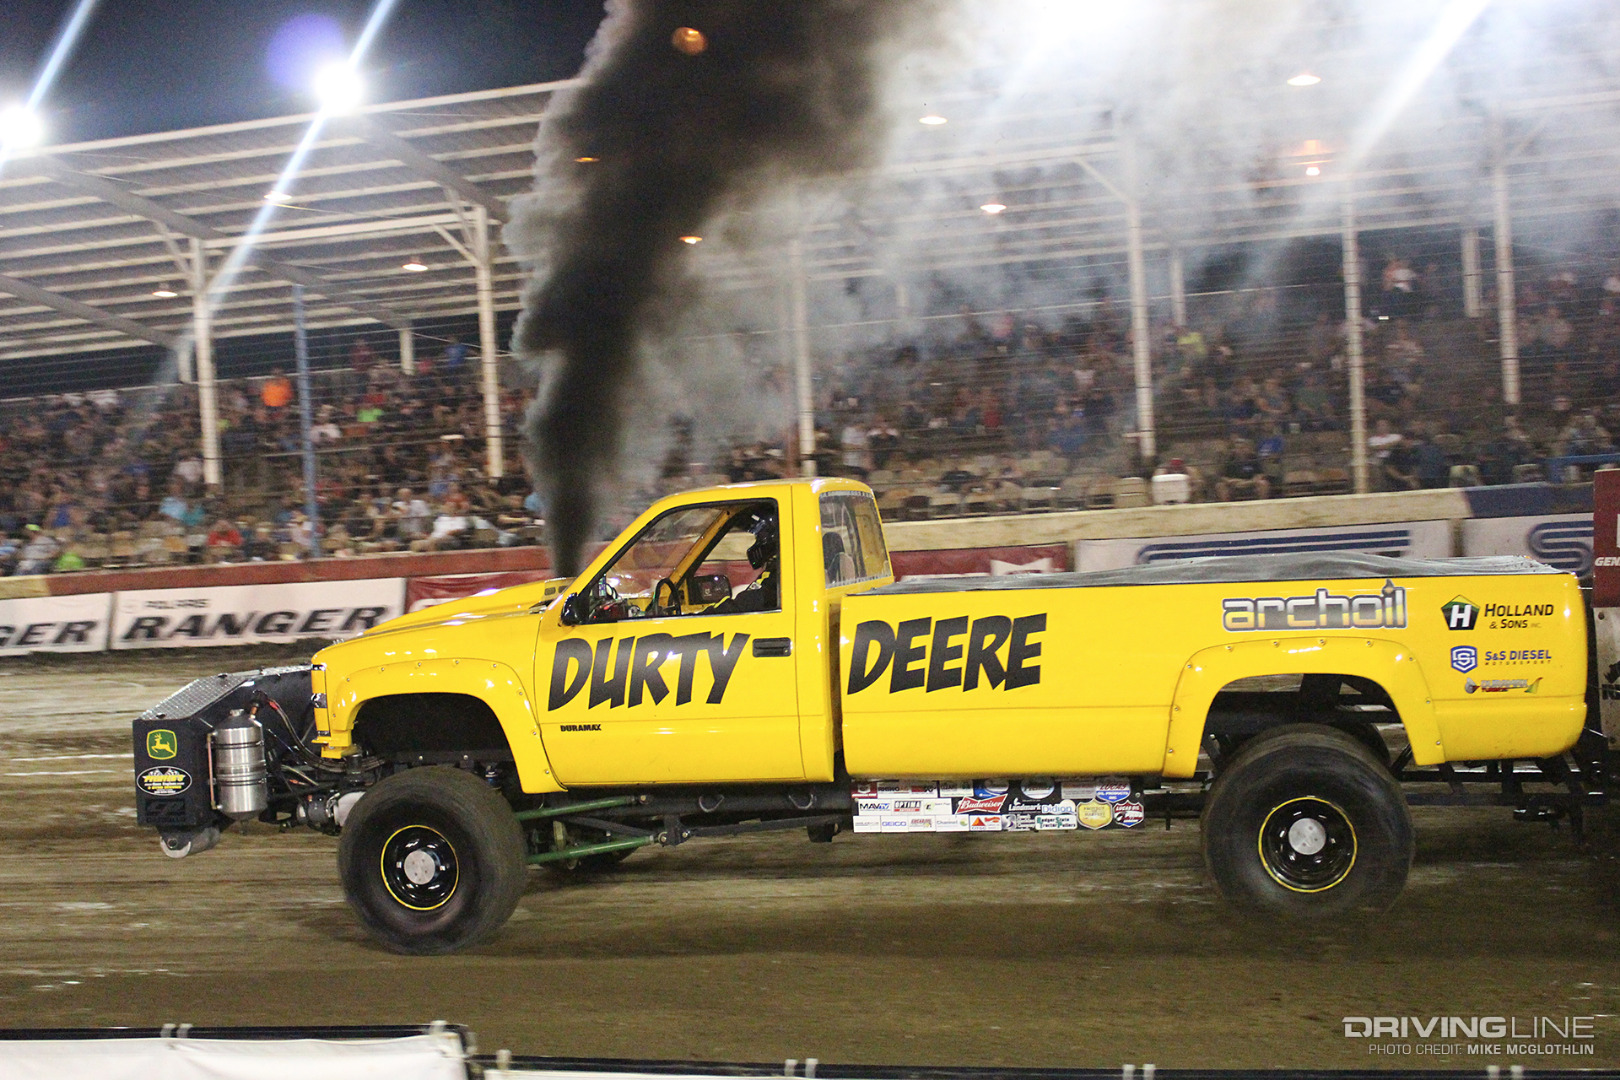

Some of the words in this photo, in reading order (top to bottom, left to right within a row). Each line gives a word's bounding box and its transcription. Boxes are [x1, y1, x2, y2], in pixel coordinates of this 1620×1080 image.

[1222, 579, 1407, 631] archoil
[1484, 603, 1554, 617] HOLLAND
[121, 606, 389, 642] RANGER
[1489, 621, 1498, 629] &
[1500, 619, 1529, 629] SONS
[847, 613, 1047, 695] DEERE
[1485, 651, 1506, 661] S&S
[1509, 650, 1552, 660] DIESEL
[547, 631, 751, 711] DURTY
[560, 724, 602, 732] DURAMAX
[961, 800, 1003, 809] Budweiser
